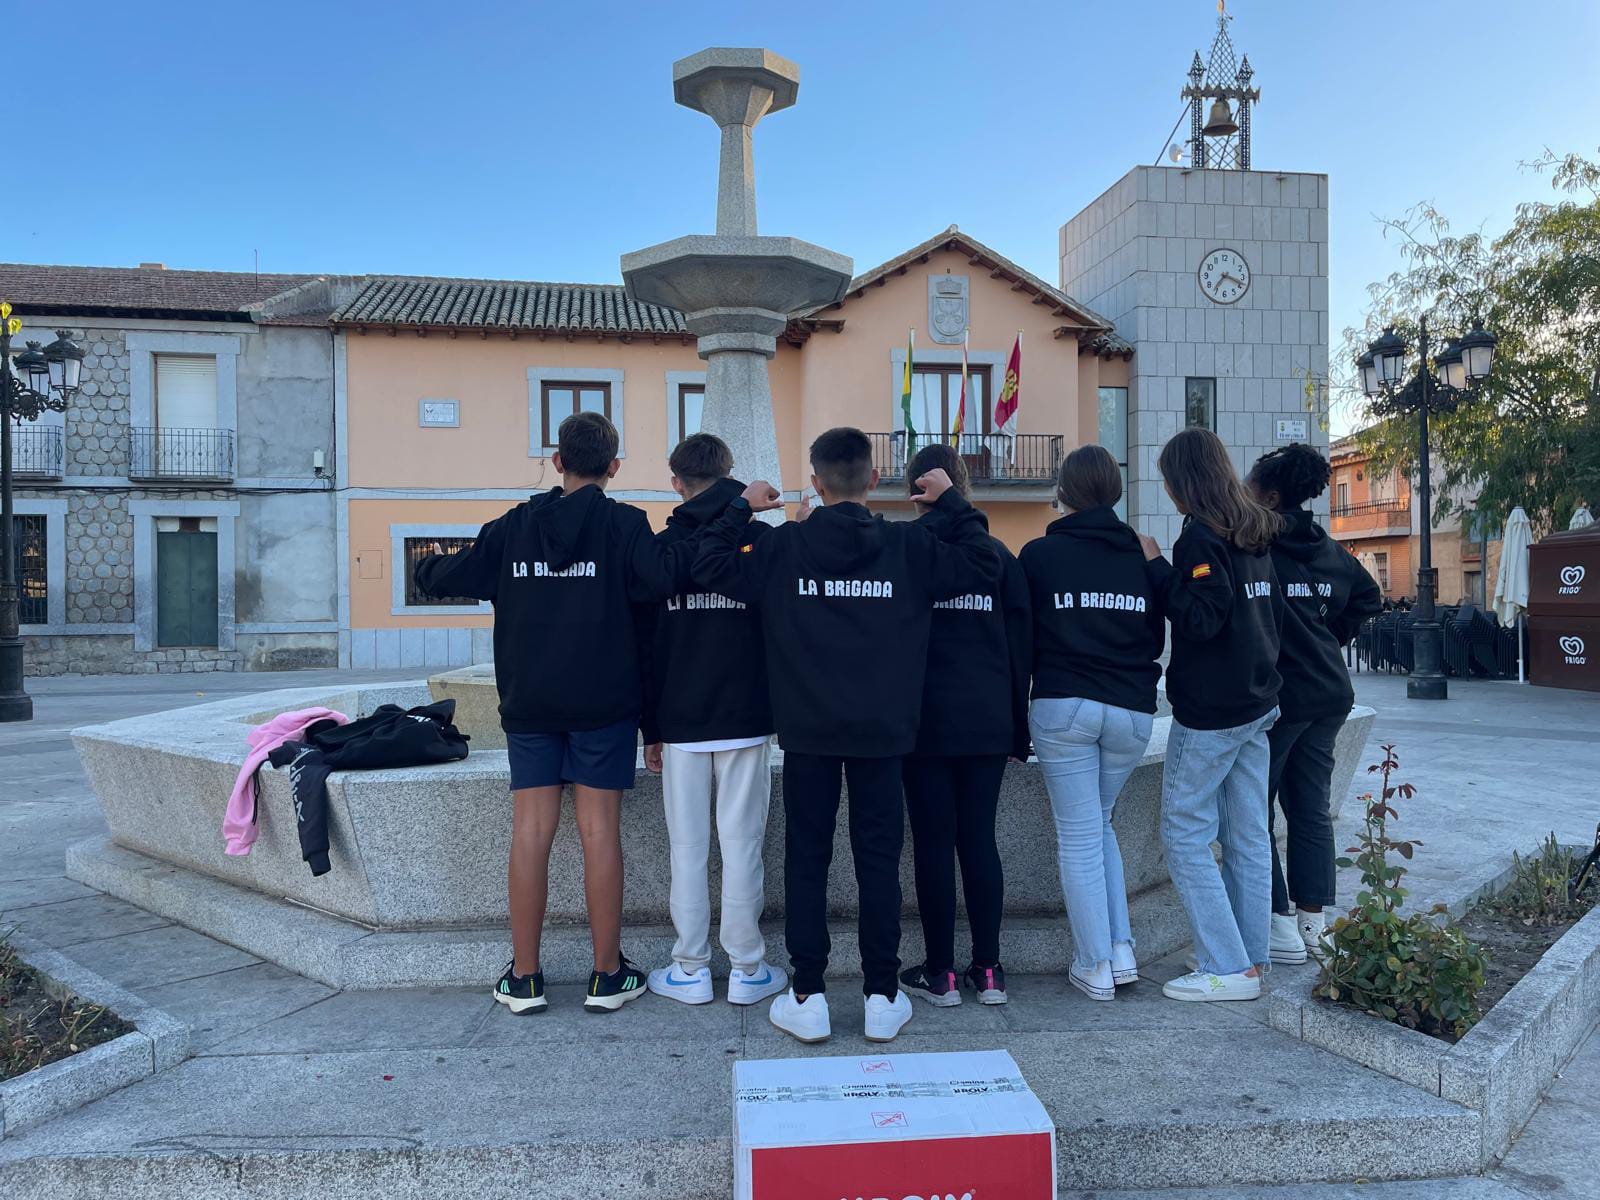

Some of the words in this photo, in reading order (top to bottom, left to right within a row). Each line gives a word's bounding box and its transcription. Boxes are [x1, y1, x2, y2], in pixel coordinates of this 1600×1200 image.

[1221, 254, 1229, 262] 12
[1207, 263, 1214, 271] 10
[512, 561, 528, 578] LA
[799, 578, 818, 595] LA
[1559, 586, 1579, 595] FRIGO
[1054, 592, 1074, 609] LA
[1565, 656, 1586, 665] FRIGO
